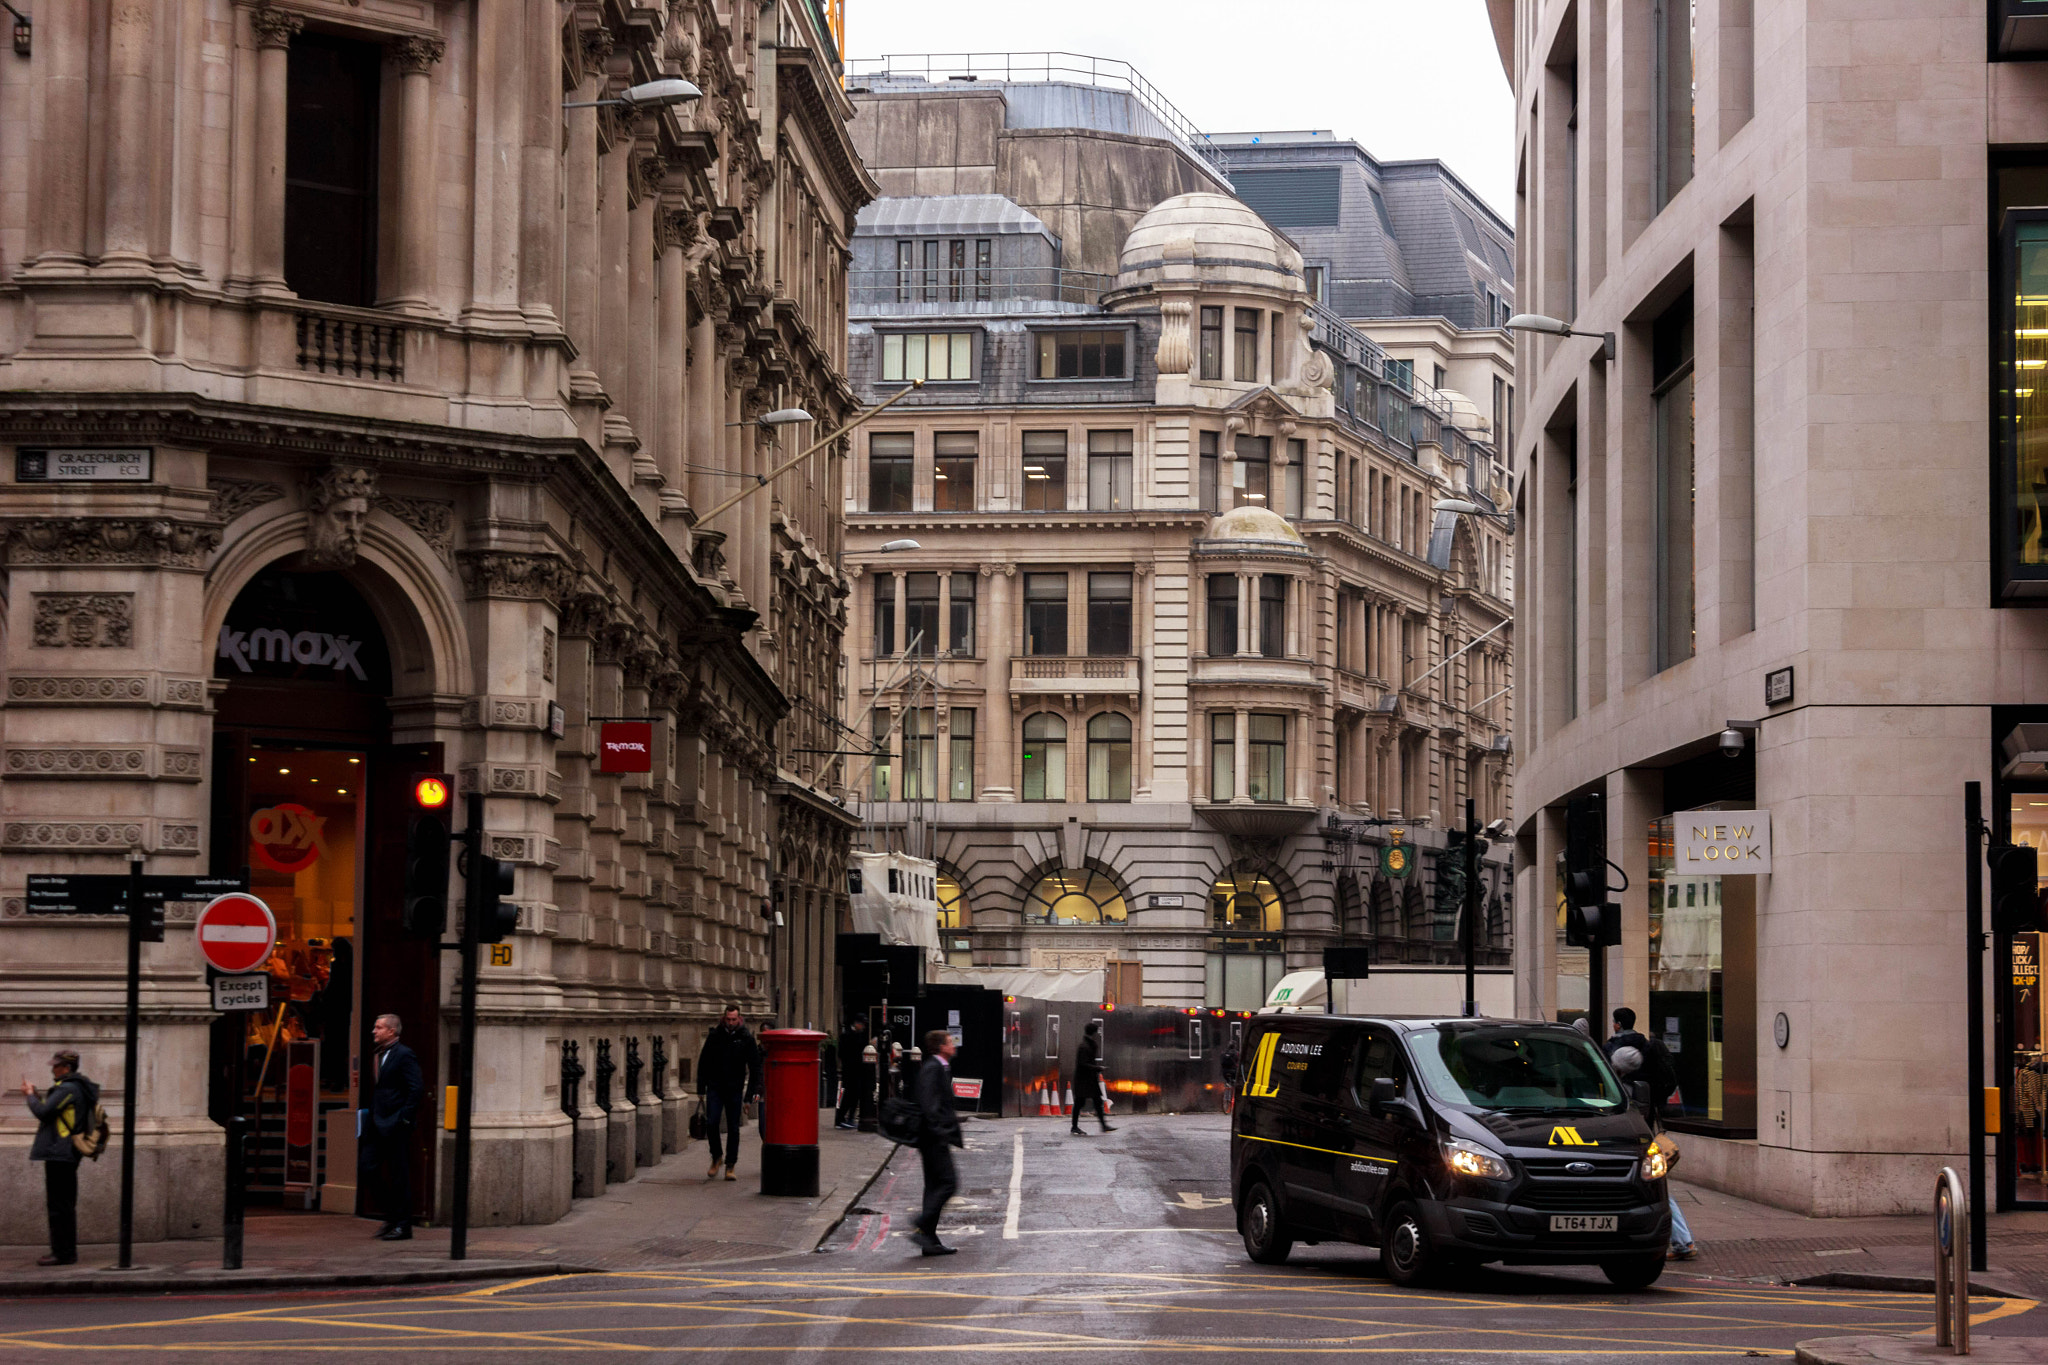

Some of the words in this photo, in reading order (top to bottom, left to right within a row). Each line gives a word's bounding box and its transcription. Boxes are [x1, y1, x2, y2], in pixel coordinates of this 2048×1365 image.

[58, 454, 140, 463] GRACECHURCH
[58, 466, 98, 475] STREET
[120, 465, 140, 475] EC3
[1693, 825, 1754, 840] NEW
[1686, 845, 1761, 861] LOOK
[220, 981, 263, 991] Except
[222, 994, 261, 1005] cycles
[893, 1015, 910, 1026] isg
[1280, 1043, 1309, 1055] ADDISON
[1309, 1044, 1323, 1056] LEE
[1287, 1061, 1308, 1071] COURIER
[1350, 1160, 1389, 1175] addisonlee.com
[1555, 1217, 1587, 1229] LT64
[1590, 1217, 1613, 1229] TJX
